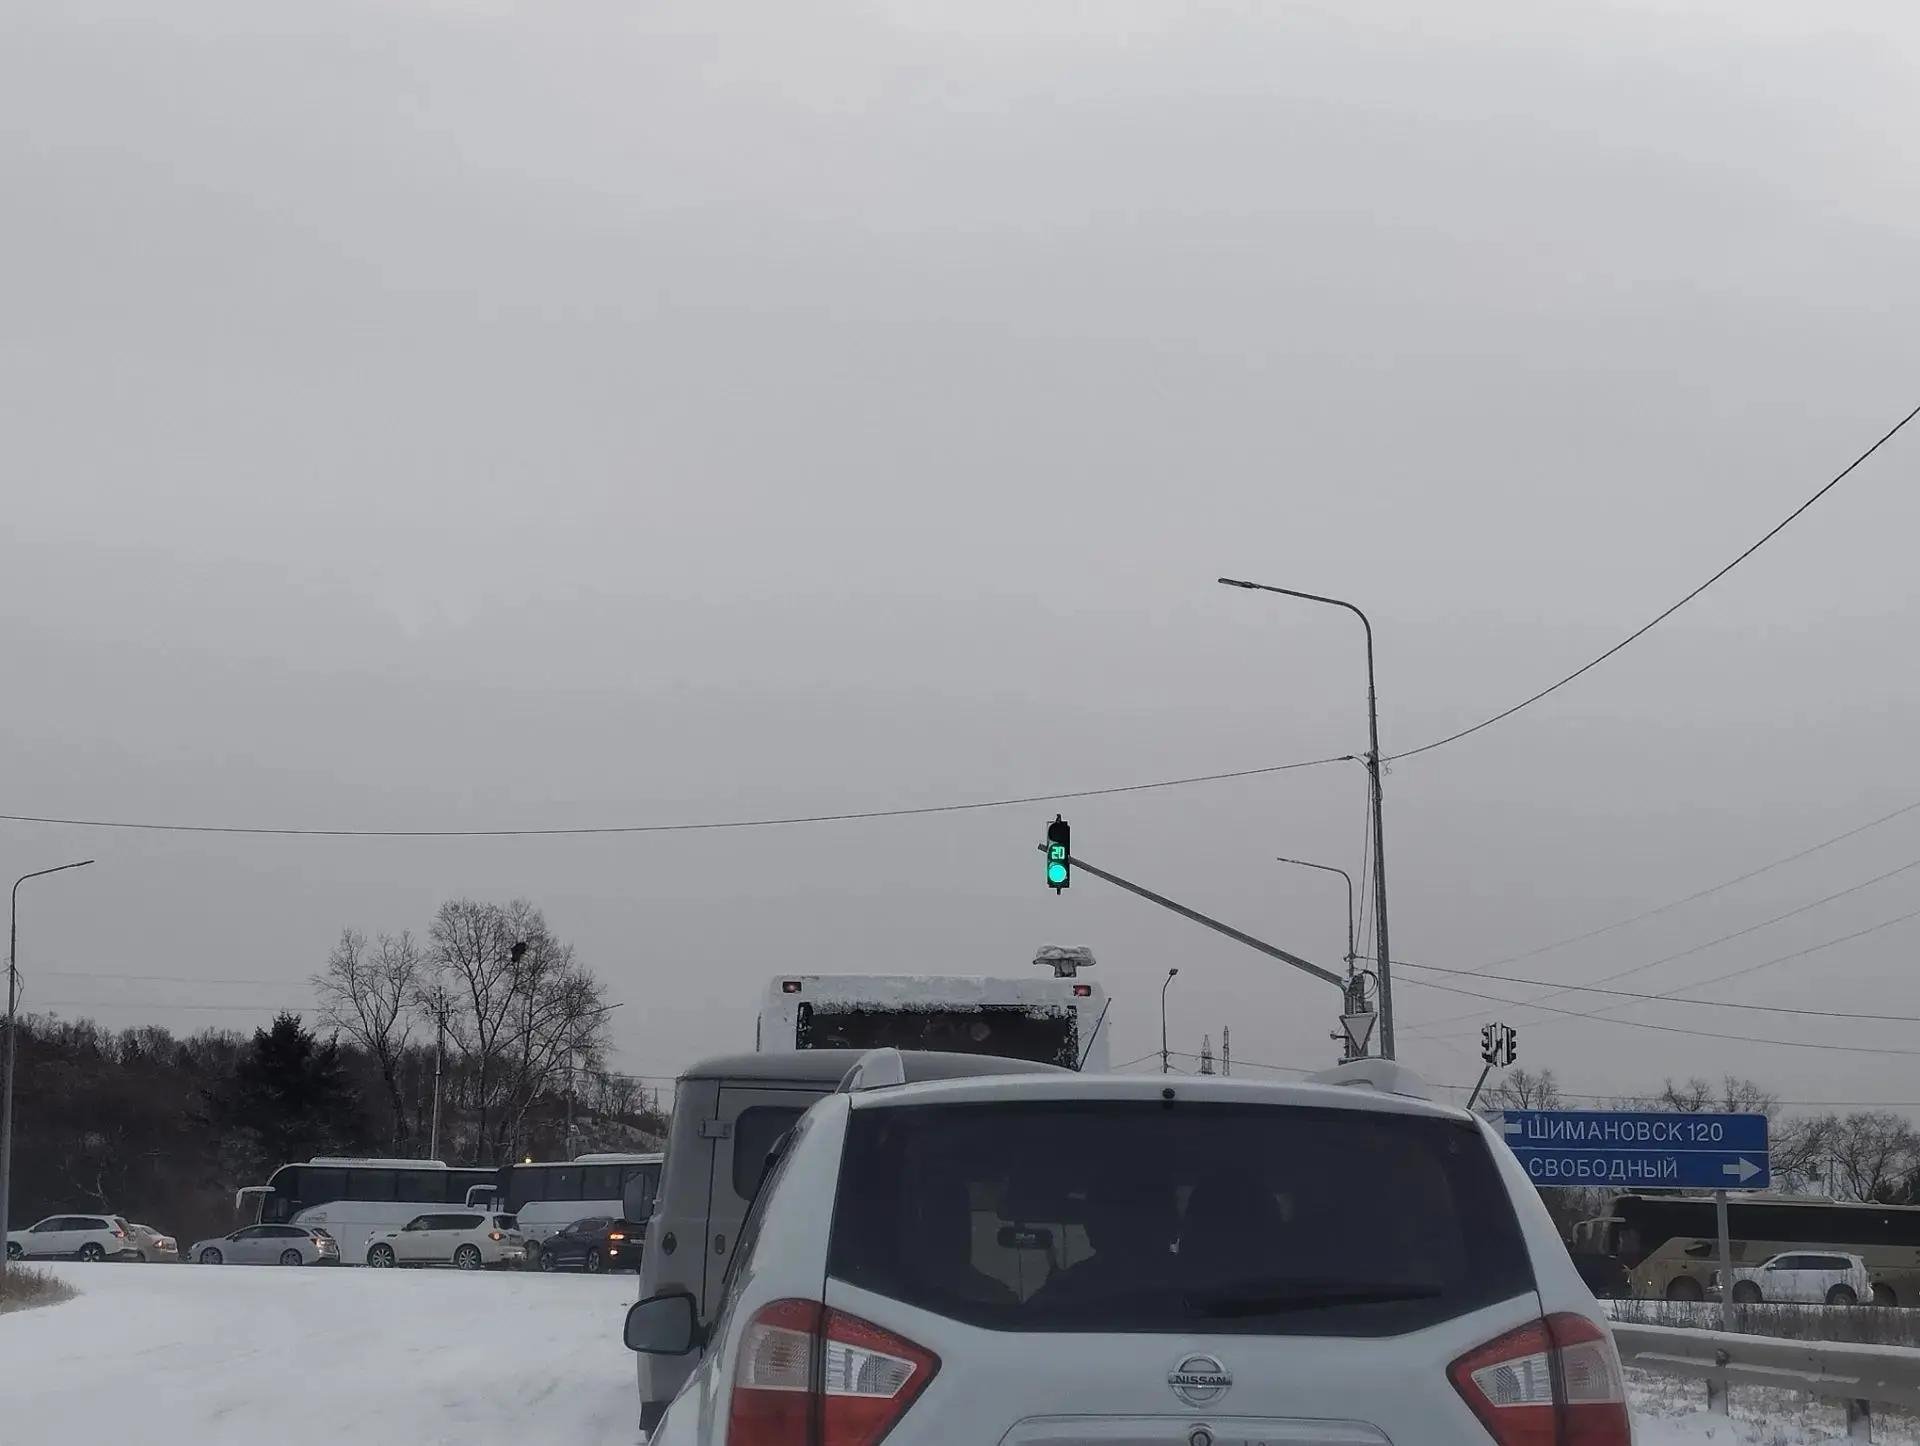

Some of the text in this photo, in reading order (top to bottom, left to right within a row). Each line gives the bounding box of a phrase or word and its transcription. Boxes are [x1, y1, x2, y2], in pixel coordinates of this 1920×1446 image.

[1051, 846, 1065, 860] 20
[1527, 1117, 1724, 1142] ШИМАНОВСК 120
[1528, 1156, 1678, 1181] СВОБОДНЫЙ
[1173, 1375, 1226, 1386] NISSAN
